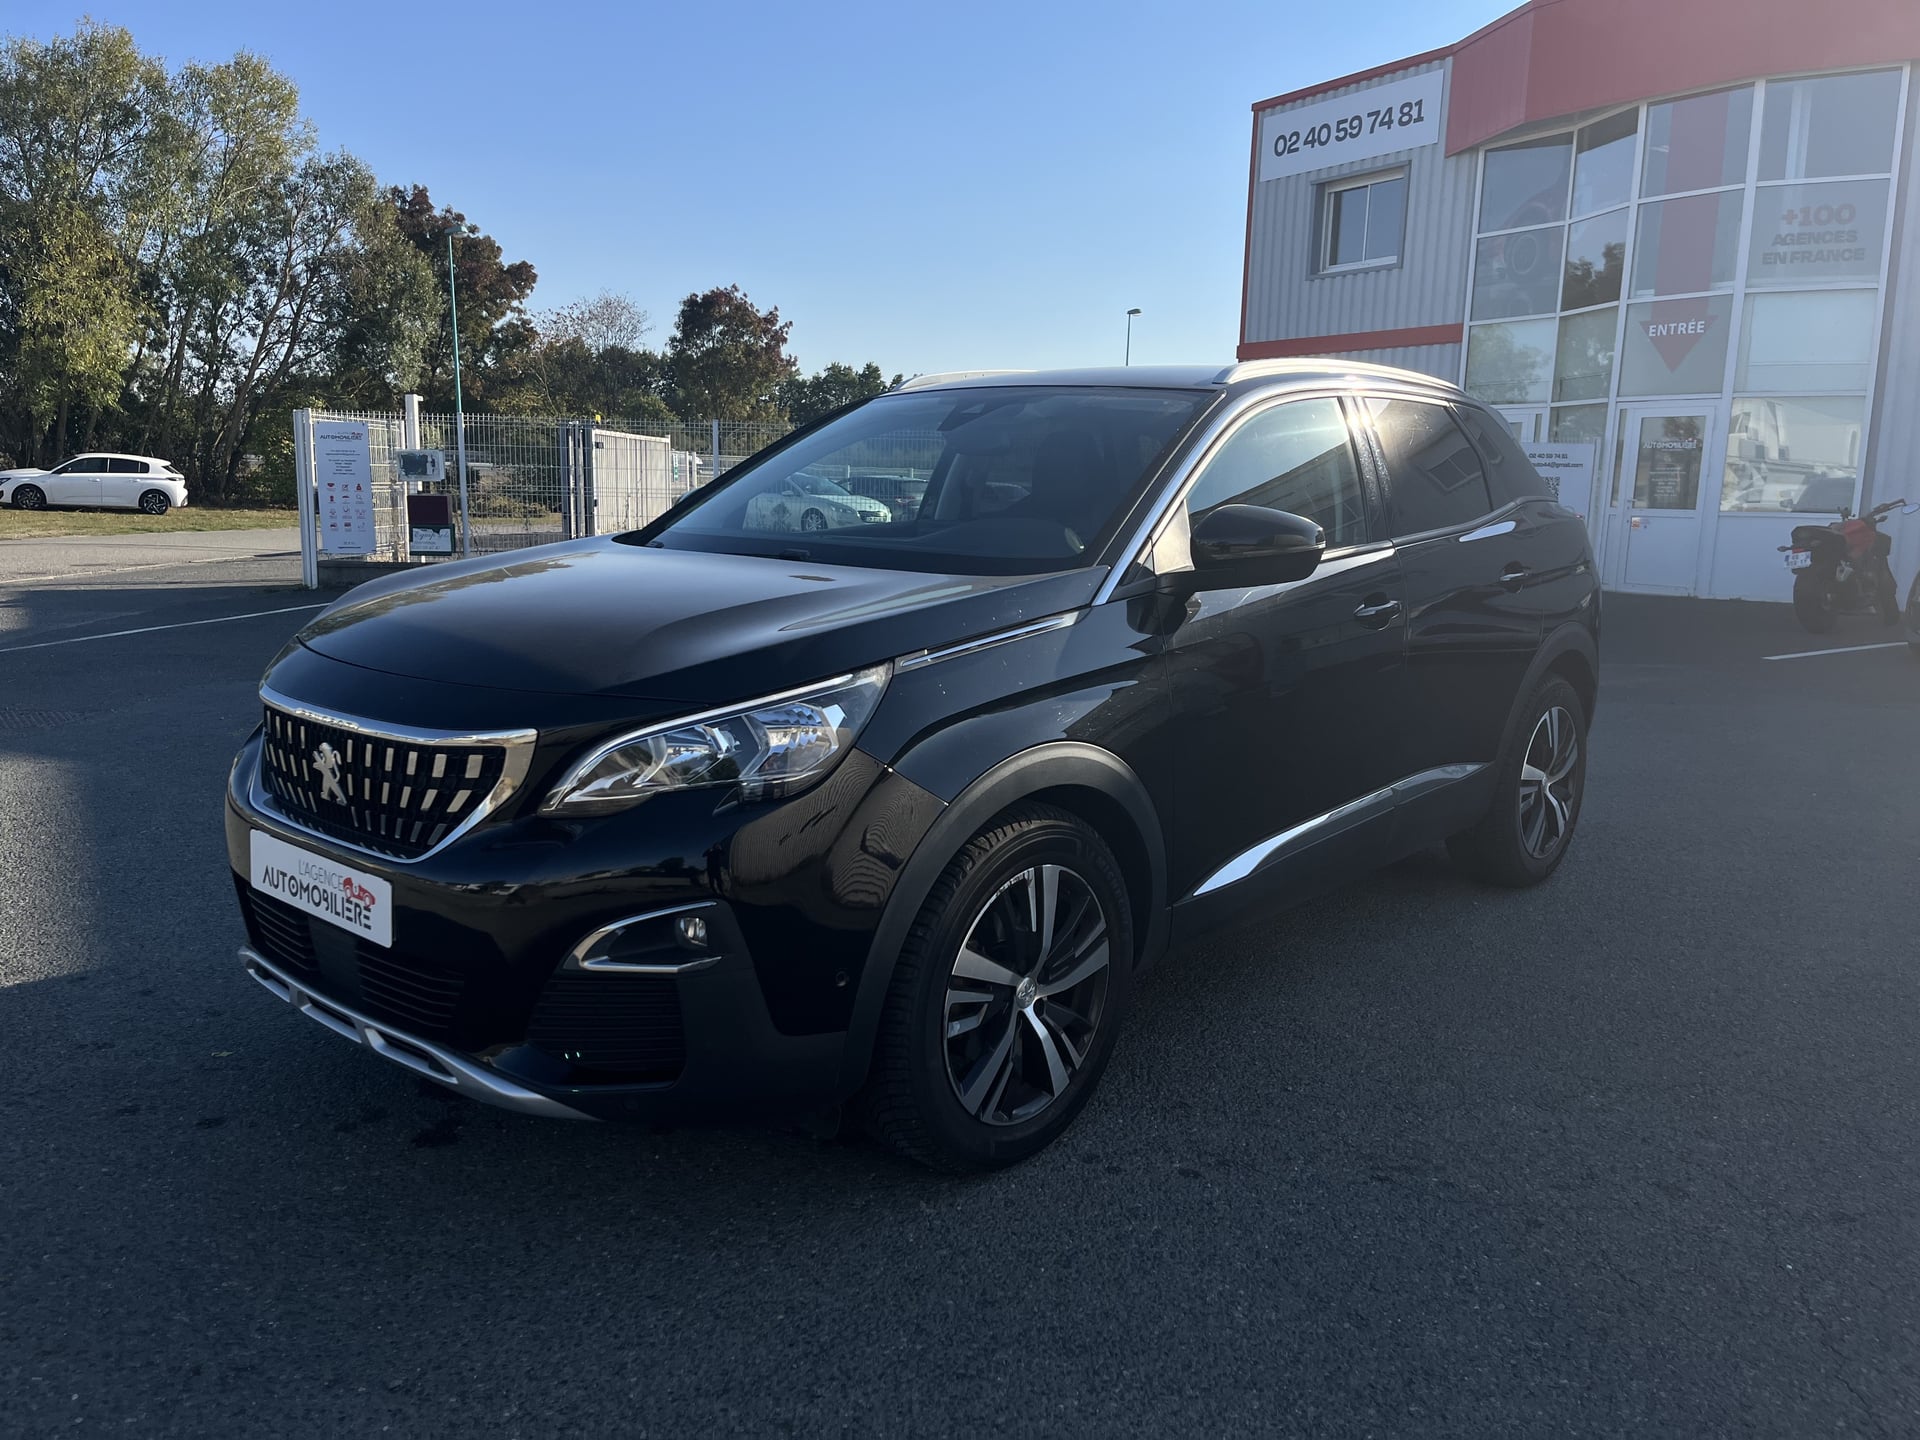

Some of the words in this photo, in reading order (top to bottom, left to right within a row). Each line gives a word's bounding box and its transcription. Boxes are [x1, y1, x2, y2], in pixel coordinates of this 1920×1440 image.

[1274, 131, 1300, 156] 02
[1304, 123, 1331, 148] 40
[1335, 115, 1363, 142] 59
[1367, 107, 1394, 134] 74
[1398, 99, 1424, 126] 81
[1782, 203, 1856, 226] +100
[1771, 230, 1858, 247] AGENCES
[1762, 251, 1786, 265] EN
[1789, 248, 1866, 264] FRANCE
[1648, 318, 1706, 337] ENTRÉE
[298, 859, 345, 892] L'AGENCE
